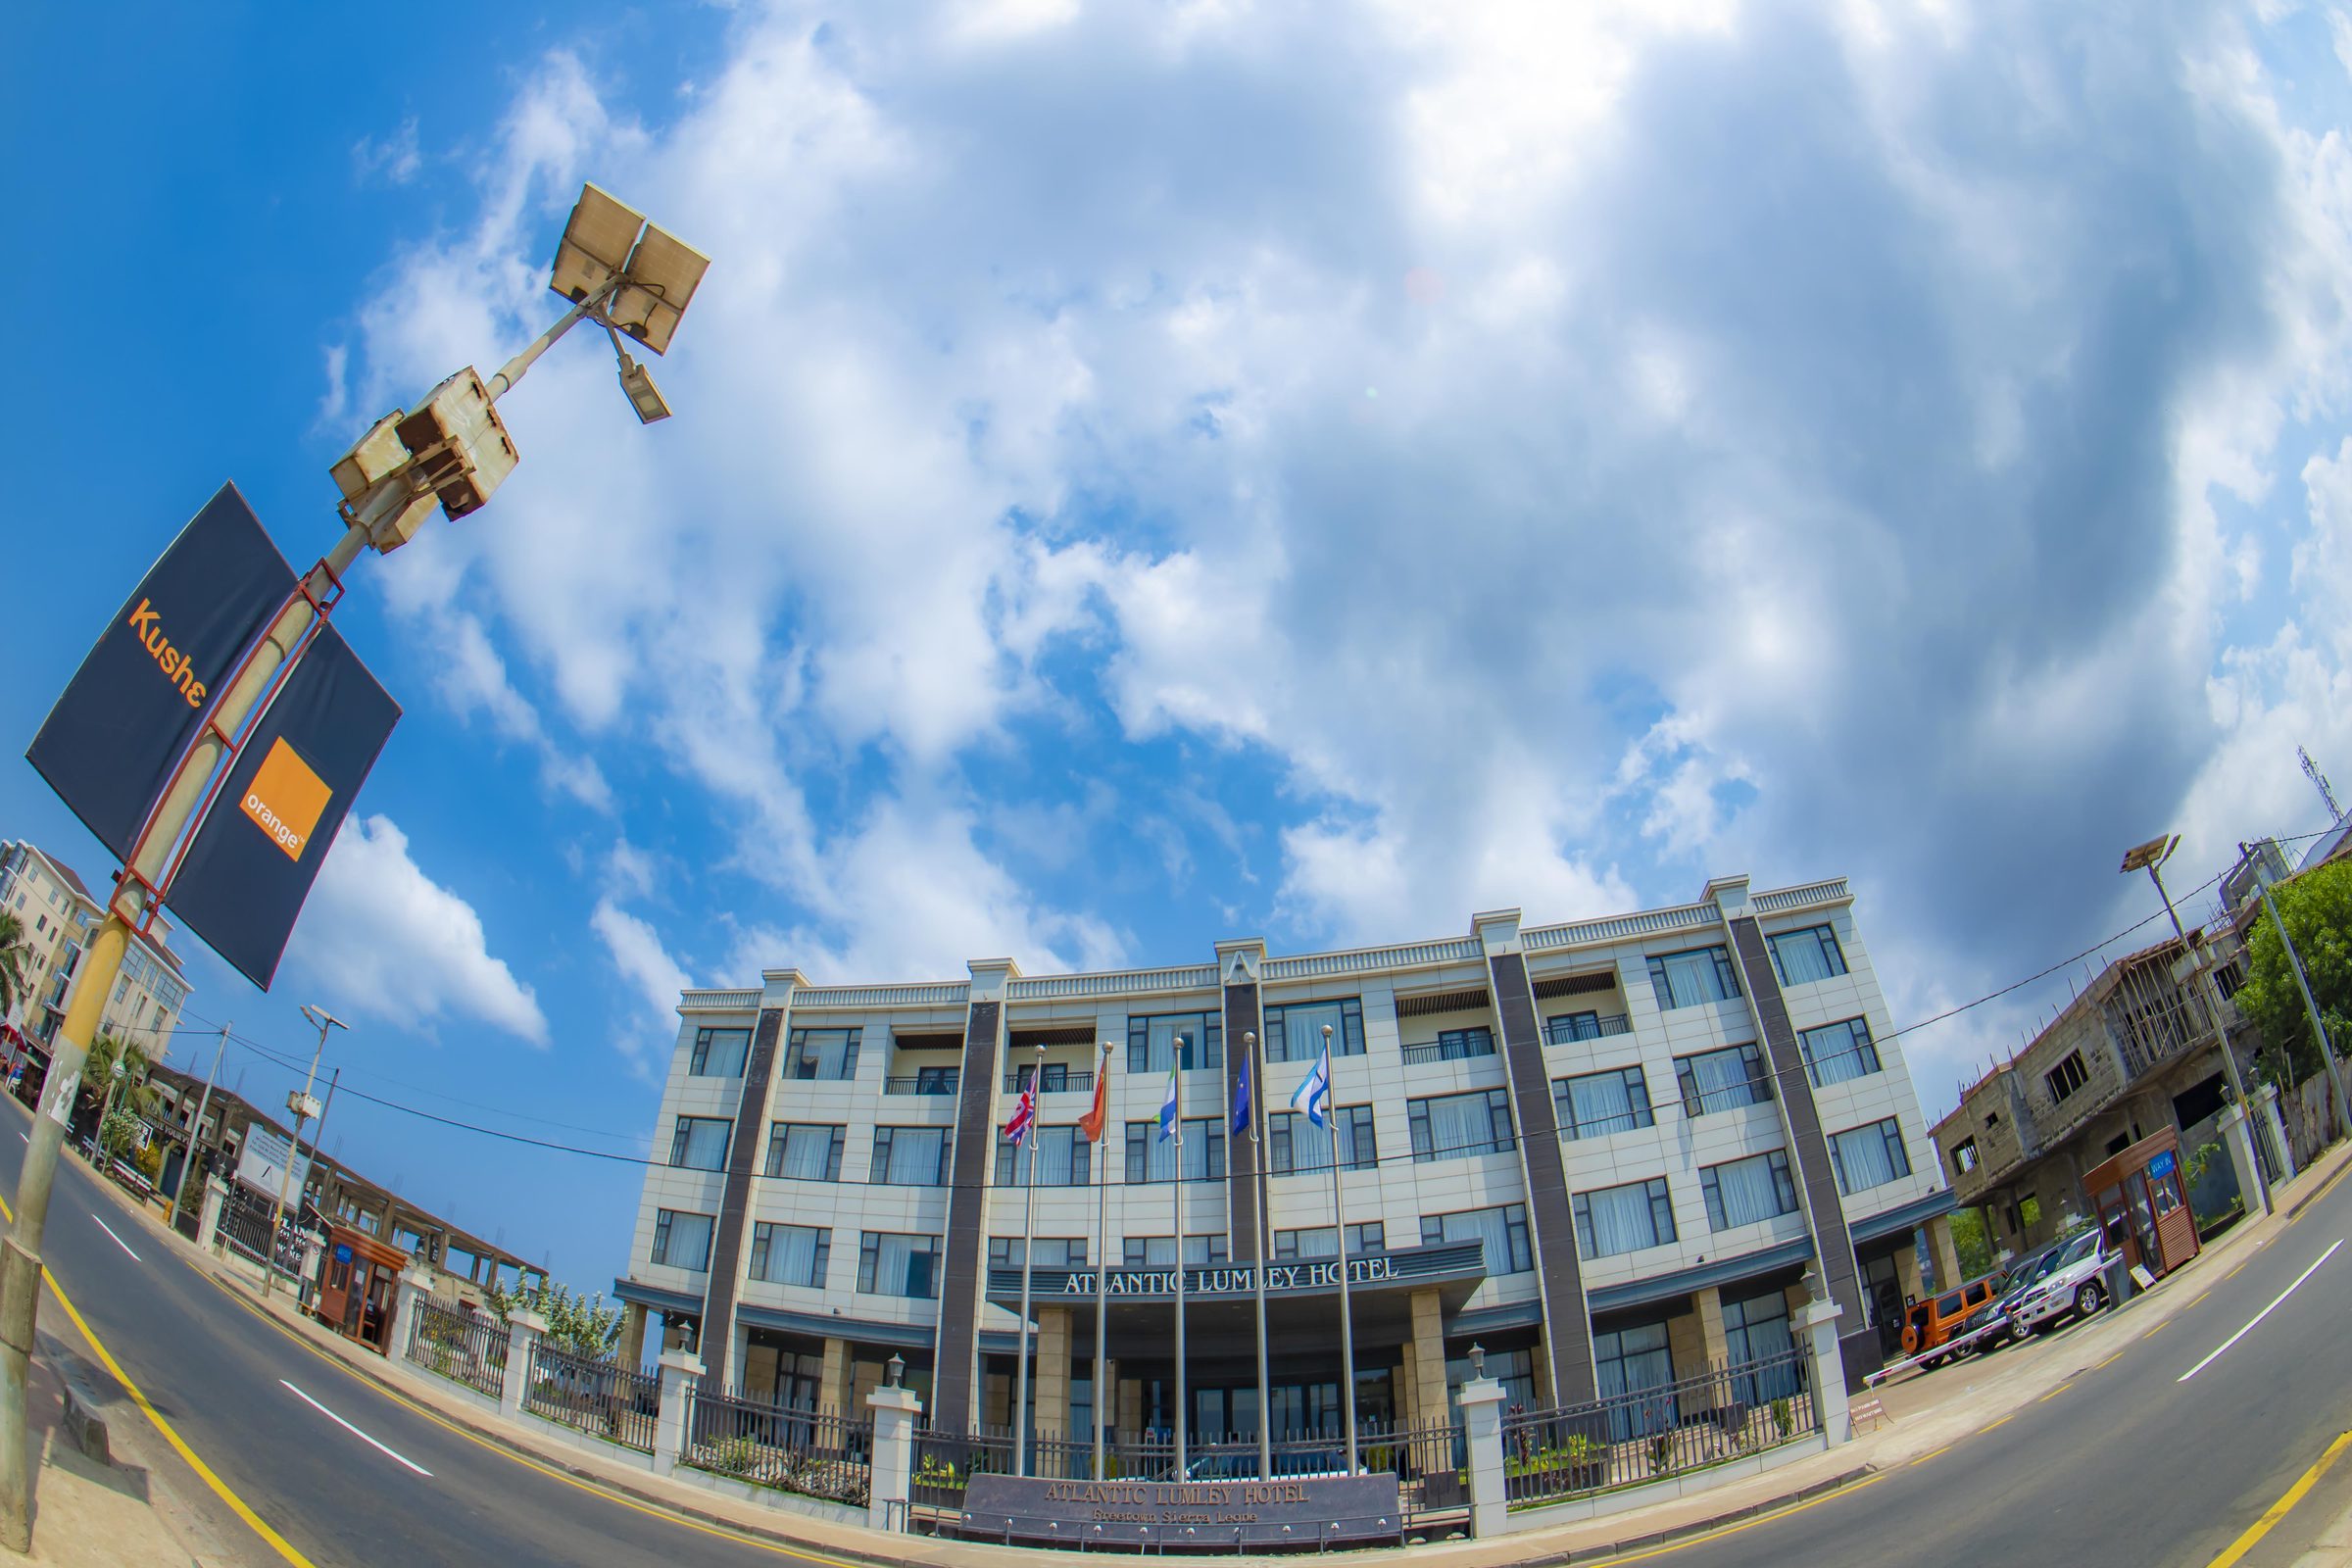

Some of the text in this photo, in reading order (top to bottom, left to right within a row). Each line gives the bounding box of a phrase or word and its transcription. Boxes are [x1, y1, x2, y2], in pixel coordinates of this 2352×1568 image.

[1064, 1256, 1401, 1293] ATLANTIC LUMLEY HOTEL
[1045, 1483, 1310, 1506] ATLANTIC LUMLEY HOTEL
[1093, 1508, 1258, 1523] Freetown Sierra Leone
